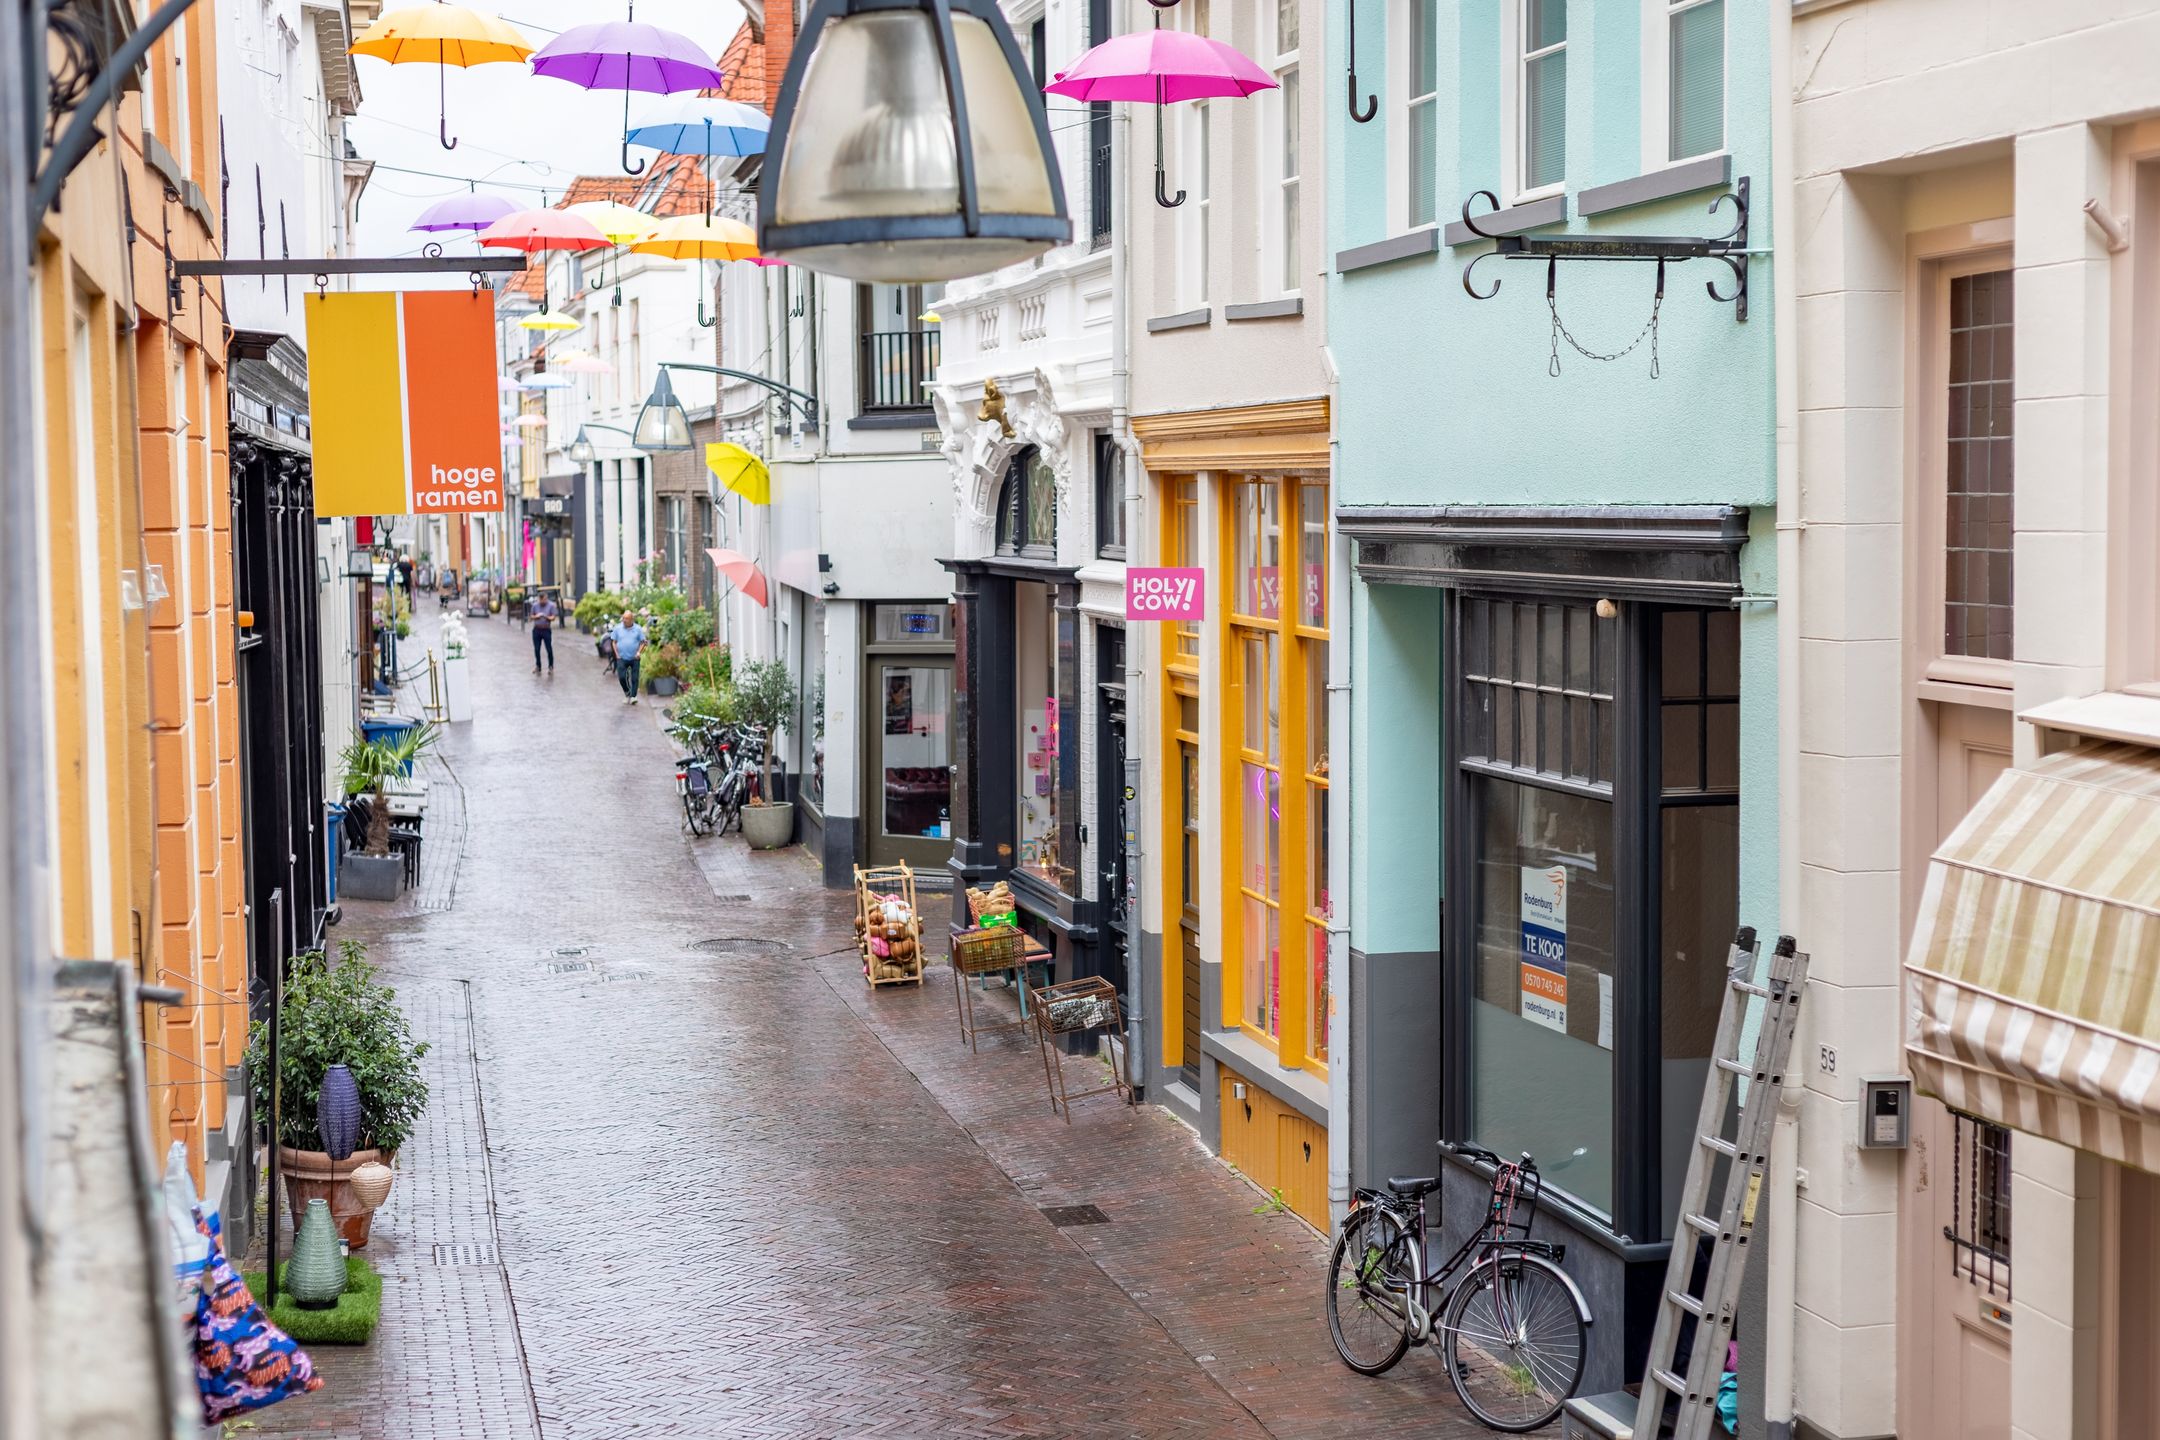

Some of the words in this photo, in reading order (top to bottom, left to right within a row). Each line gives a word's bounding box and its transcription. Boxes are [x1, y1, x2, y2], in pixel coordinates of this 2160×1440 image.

[431, 464, 496, 489] hoge
[416, 489, 498, 507] ramen
[544, 499, 563, 514] BRO
[1133, 577, 1188, 594] HOLY
[1133, 579, 1196, 611] COW!
[1524, 892, 1553, 912] Rodenburg
[1525, 933, 1536, 952] TE
[1538, 938, 1564, 961] KOOP
[1525, 972, 1541, 989] 0570
[1541, 977, 1552, 993] 745
[1553, 981, 1564, 997] 245
[1524, 1000, 1556, 1020] rodenburg.nl
[1820, 1047, 1836, 1073] 59
